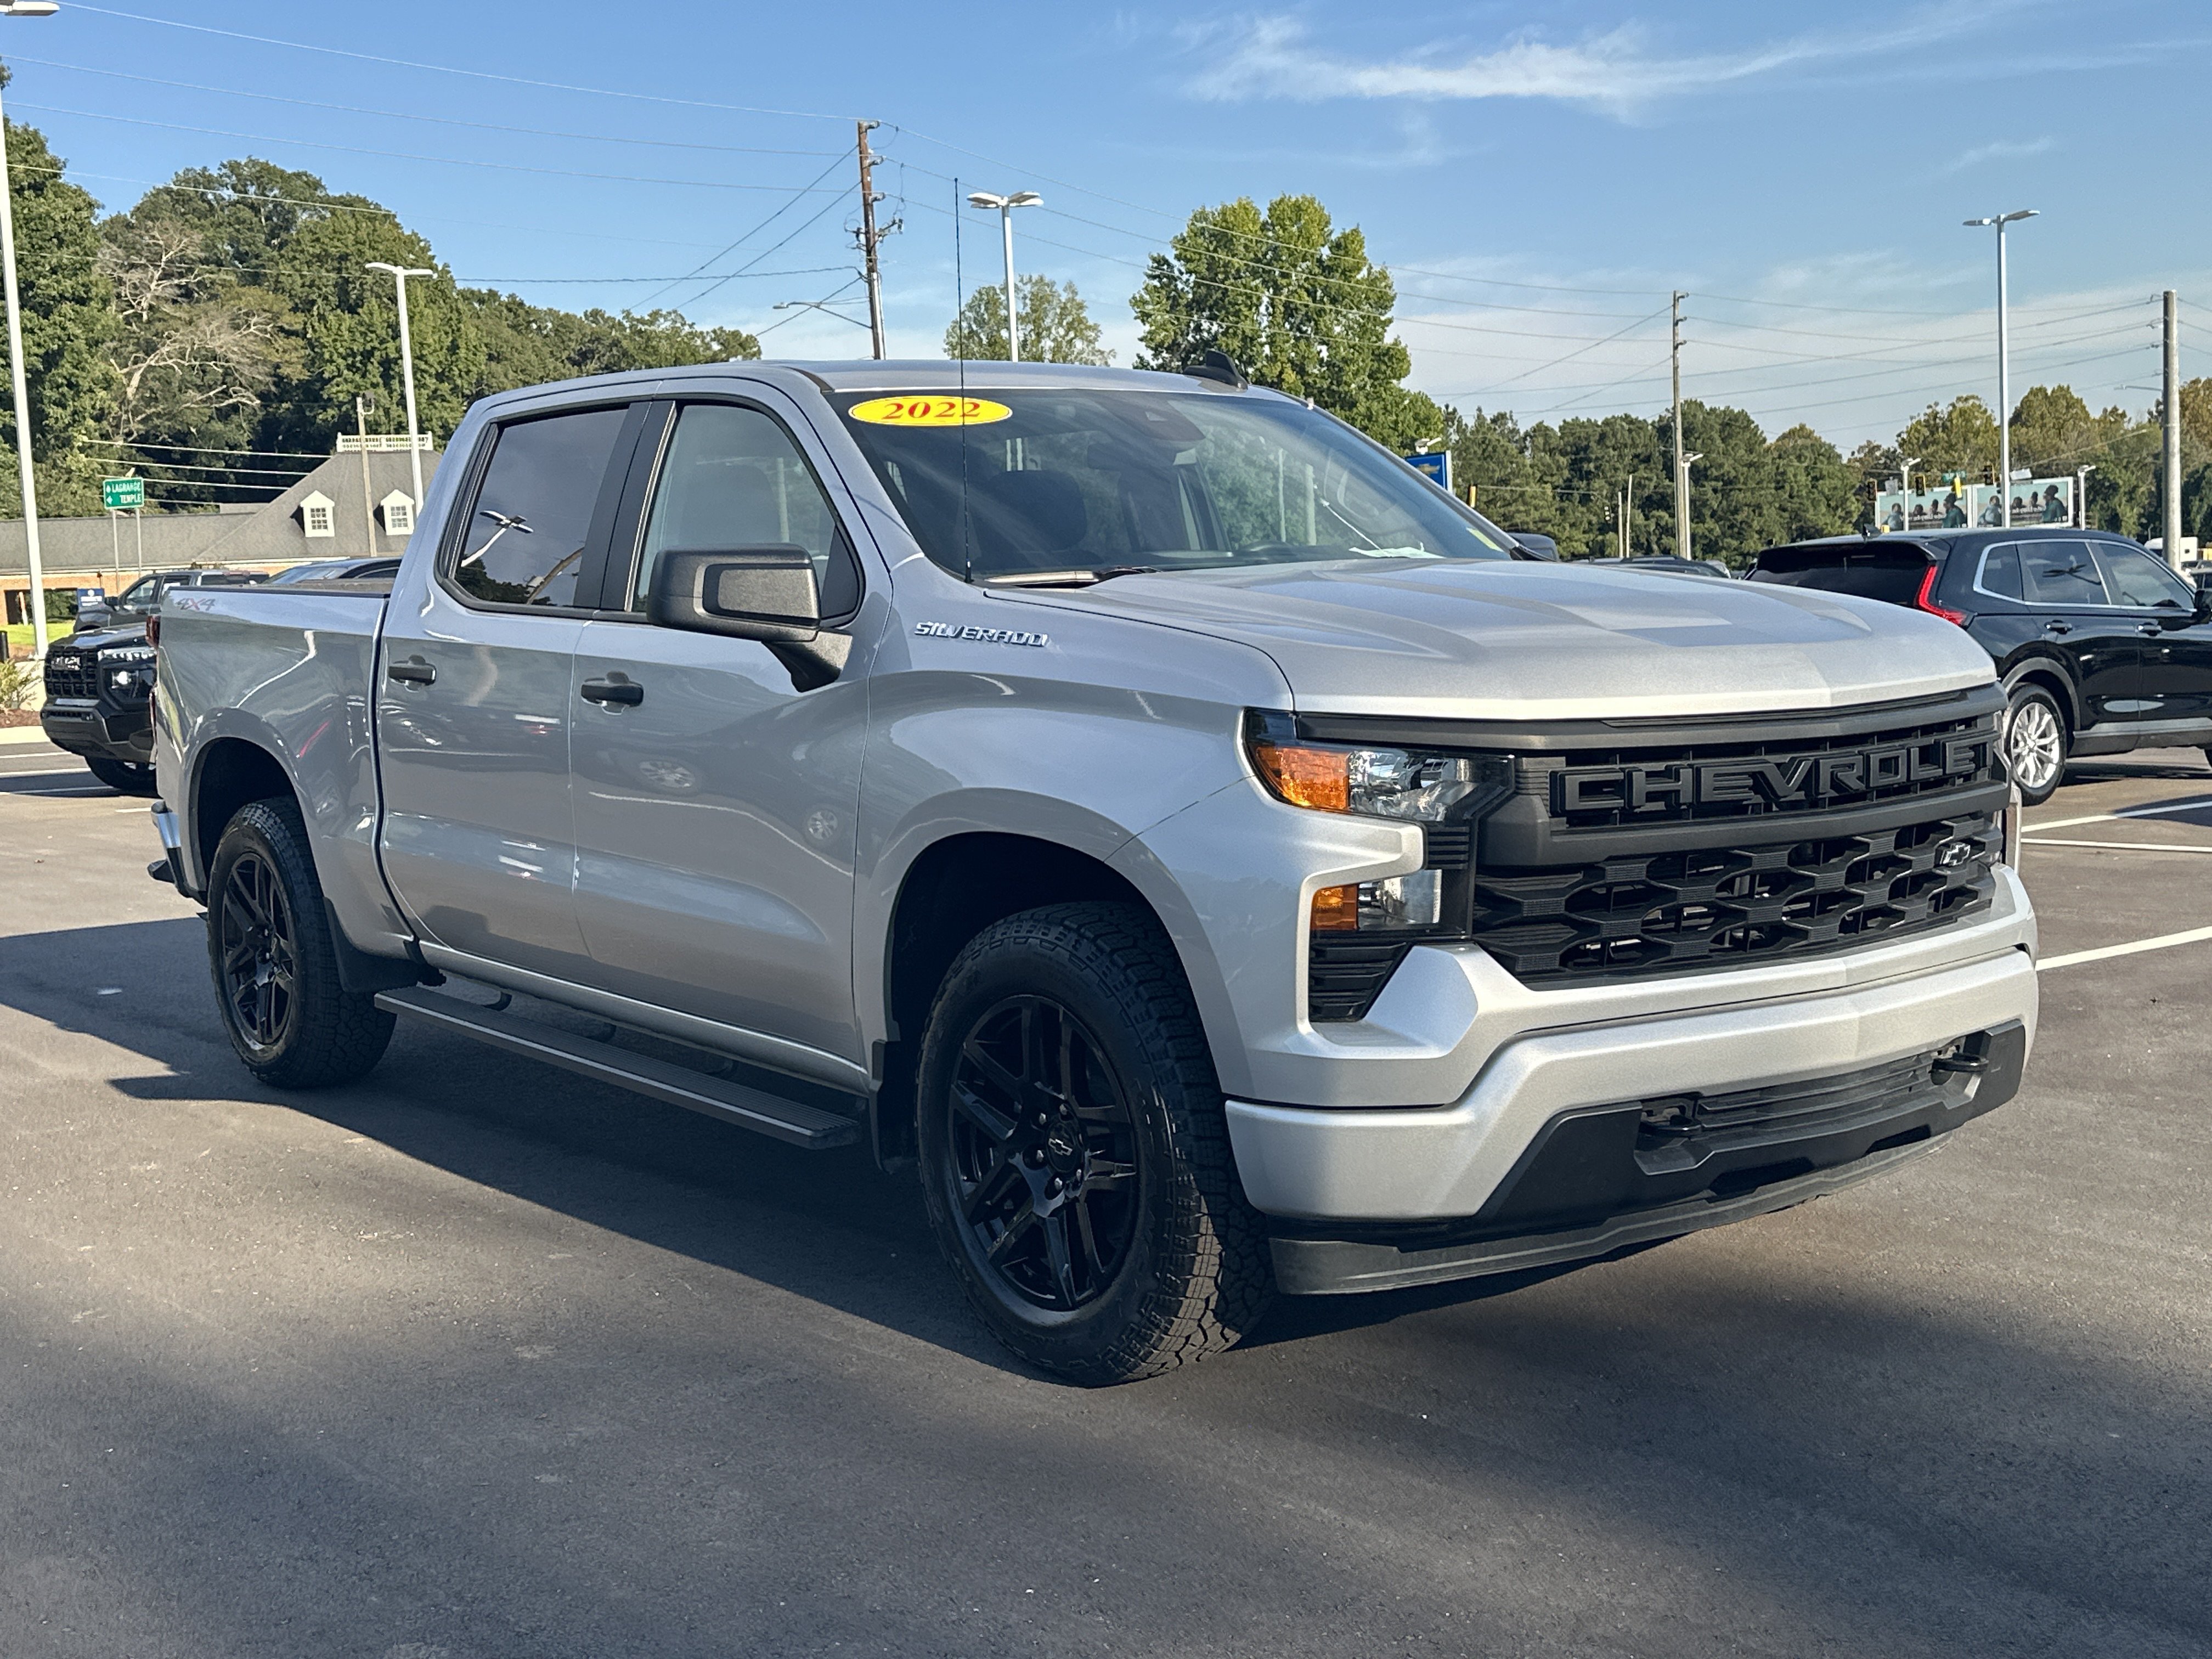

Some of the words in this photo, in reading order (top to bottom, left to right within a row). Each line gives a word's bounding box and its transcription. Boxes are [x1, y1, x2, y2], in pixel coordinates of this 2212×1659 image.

[882, 402, 980, 420] 2022
[120, 493, 142, 504] TEMPLE
[914, 621, 1048, 648] SILVERADO
[1551, 734, 2000, 815] CHEVROLET
